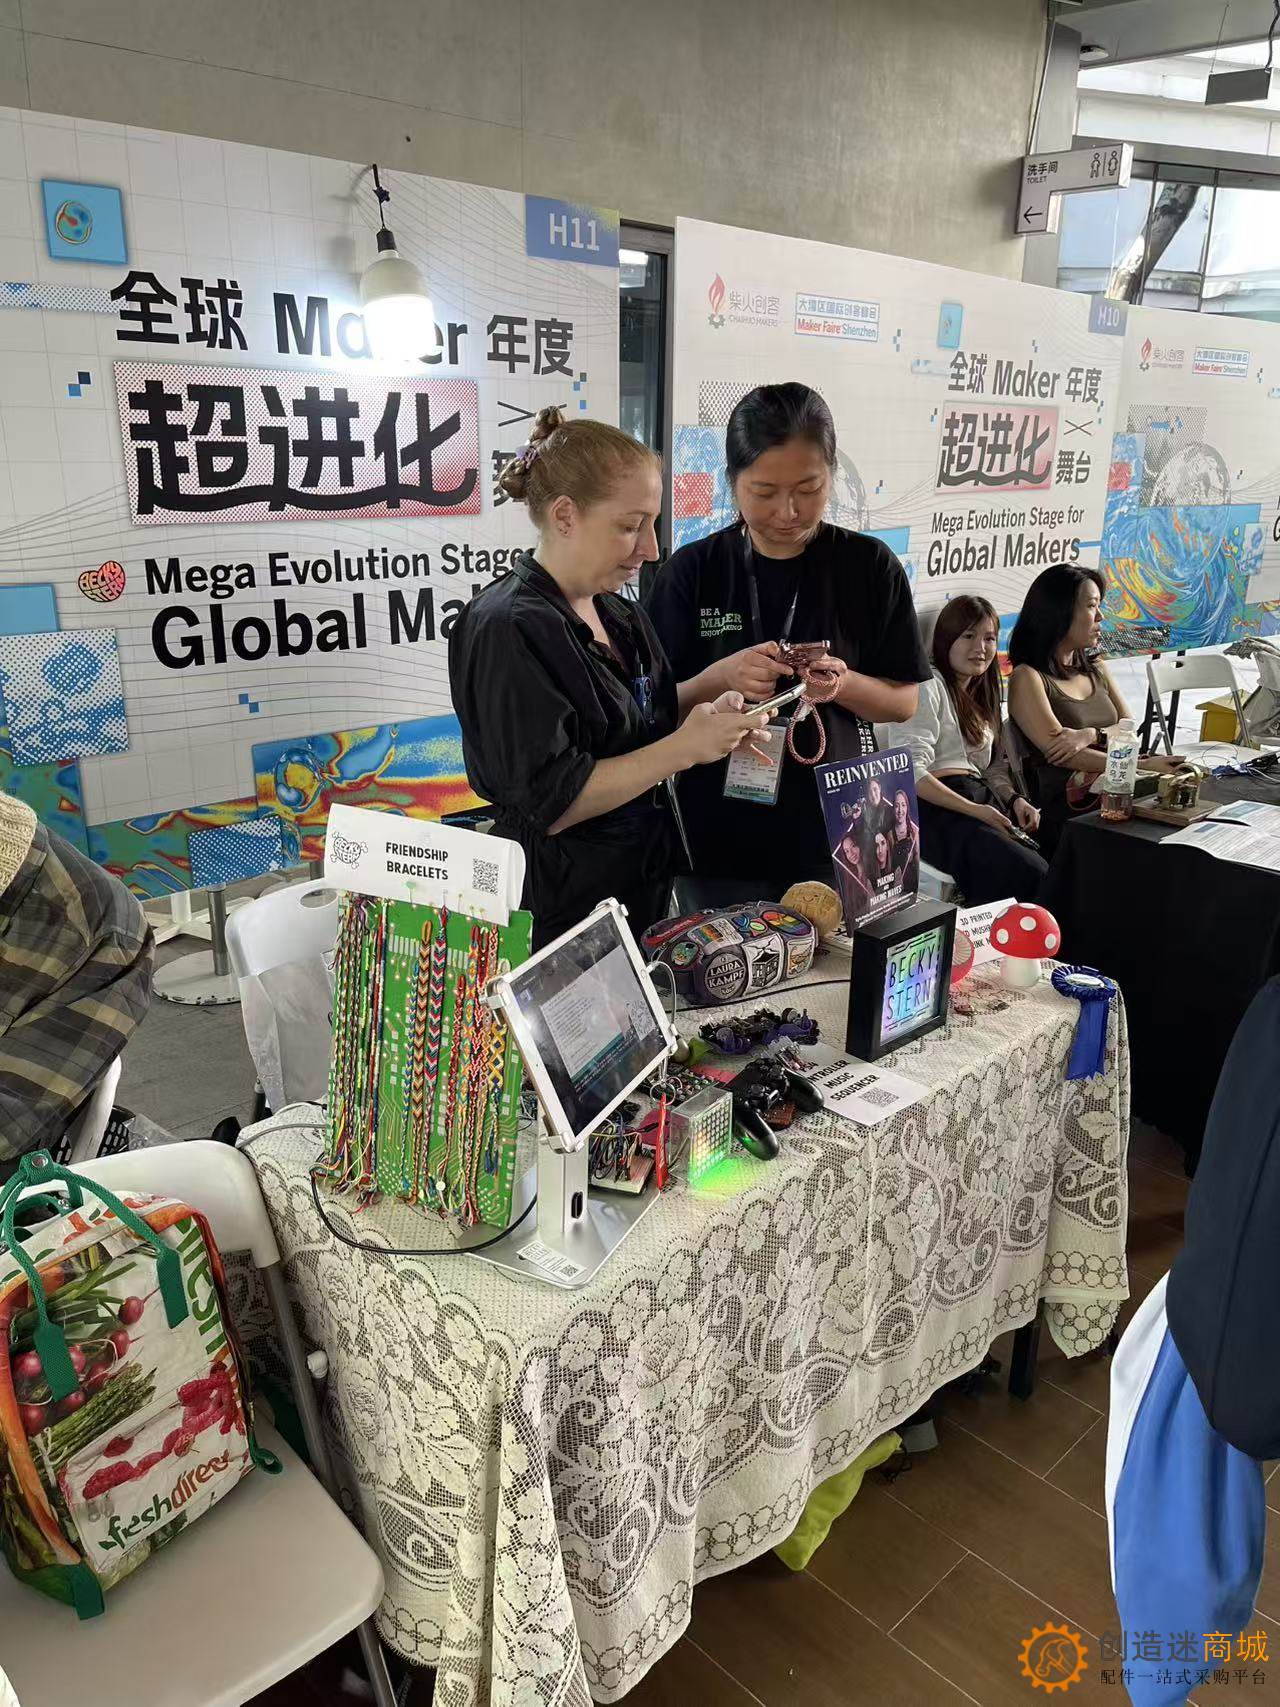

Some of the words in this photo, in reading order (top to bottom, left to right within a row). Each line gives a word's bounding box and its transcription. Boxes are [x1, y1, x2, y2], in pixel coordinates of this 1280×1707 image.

[1027, 161, 1058, 176] 洗手间
[1027, 176, 1048, 184] TOILET
[549, 212, 601, 252] H11
[110, 270, 248, 351] 全球
[487, 314, 574, 377] 年度
[797, 318, 822, 332] Maker
[823, 321, 841, 334] Faire
[842, 323, 876, 338] Shenzhen
[1097, 305, 1120, 327] H10
[948, 351, 987, 394] 全球
[992, 360, 1060, 399] Maker
[1065, 367, 1102, 404] 年度
[128, 380, 478, 515] 超进化
[936, 411, 1052, 488] 超进化
[1055, 450, 1092, 485] 舞台
[931, 512, 963, 537] Mega
[966, 508, 1026, 531] Evolution
[1029, 506, 1064, 529] Stage
[1067, 505, 1085, 524] for
[927, 535, 998, 577] Global
[1003, 532, 1081, 568] Makers
[144, 556, 256, 599] Mega
[268, 548, 430, 586] Evolution
[700, 608, 712, 617] BE
[713, 608, 720, 616] A
[151, 593, 367, 670] Global
[823, 752, 909, 789] REINVENTED
[385, 841, 449, 861] FRIENDSHIP
[386, 860, 449, 880] BRACELETS
[960, 917, 969, 926] 3D
[969, 912, 993, 924] PRINTED
[708, 969, 744, 988] KAMPF
[710, 961, 741, 976] LAURA
[888, 943, 935, 988] BECKY
[886, 976, 933, 1020] STERN
[823, 1072, 854, 1089] MUSIC
[830, 1074, 880, 1101] SEQUENCER
